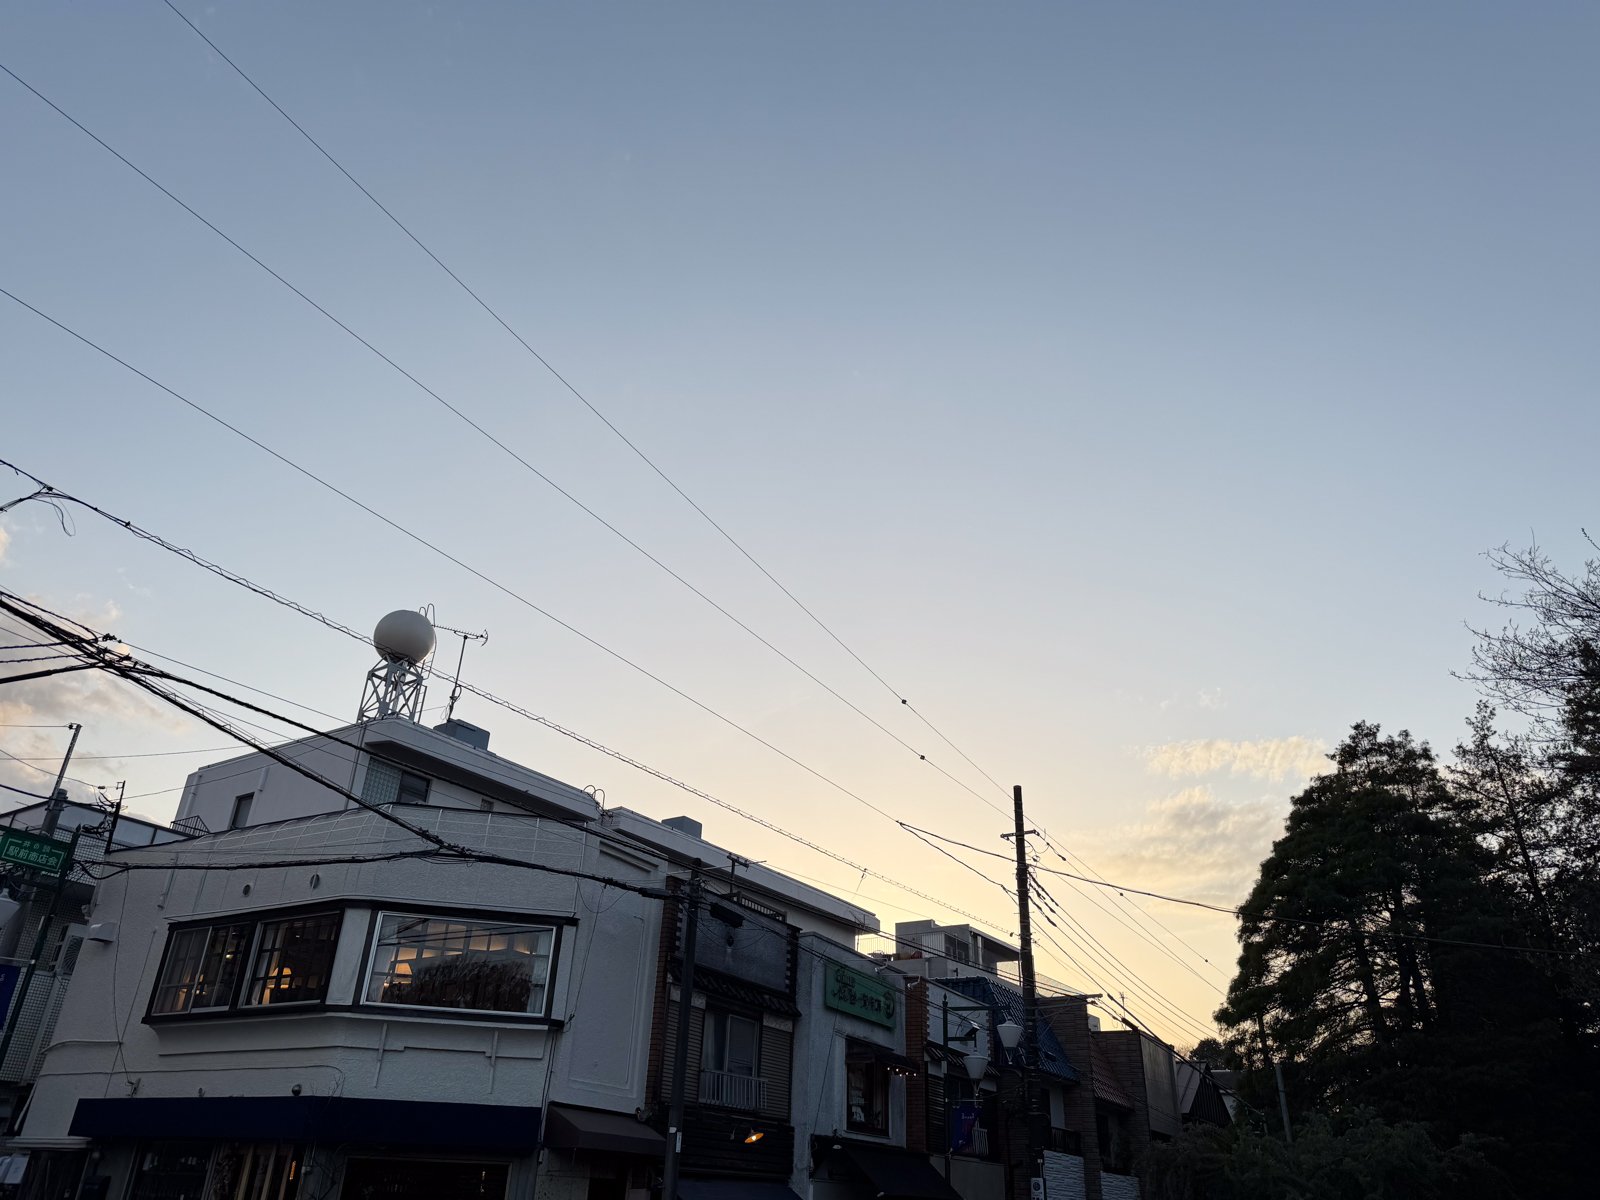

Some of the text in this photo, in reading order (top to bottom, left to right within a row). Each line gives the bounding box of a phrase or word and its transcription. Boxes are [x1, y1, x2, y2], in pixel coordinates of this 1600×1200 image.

[6, 845, 58, 867] 駅前商店会
